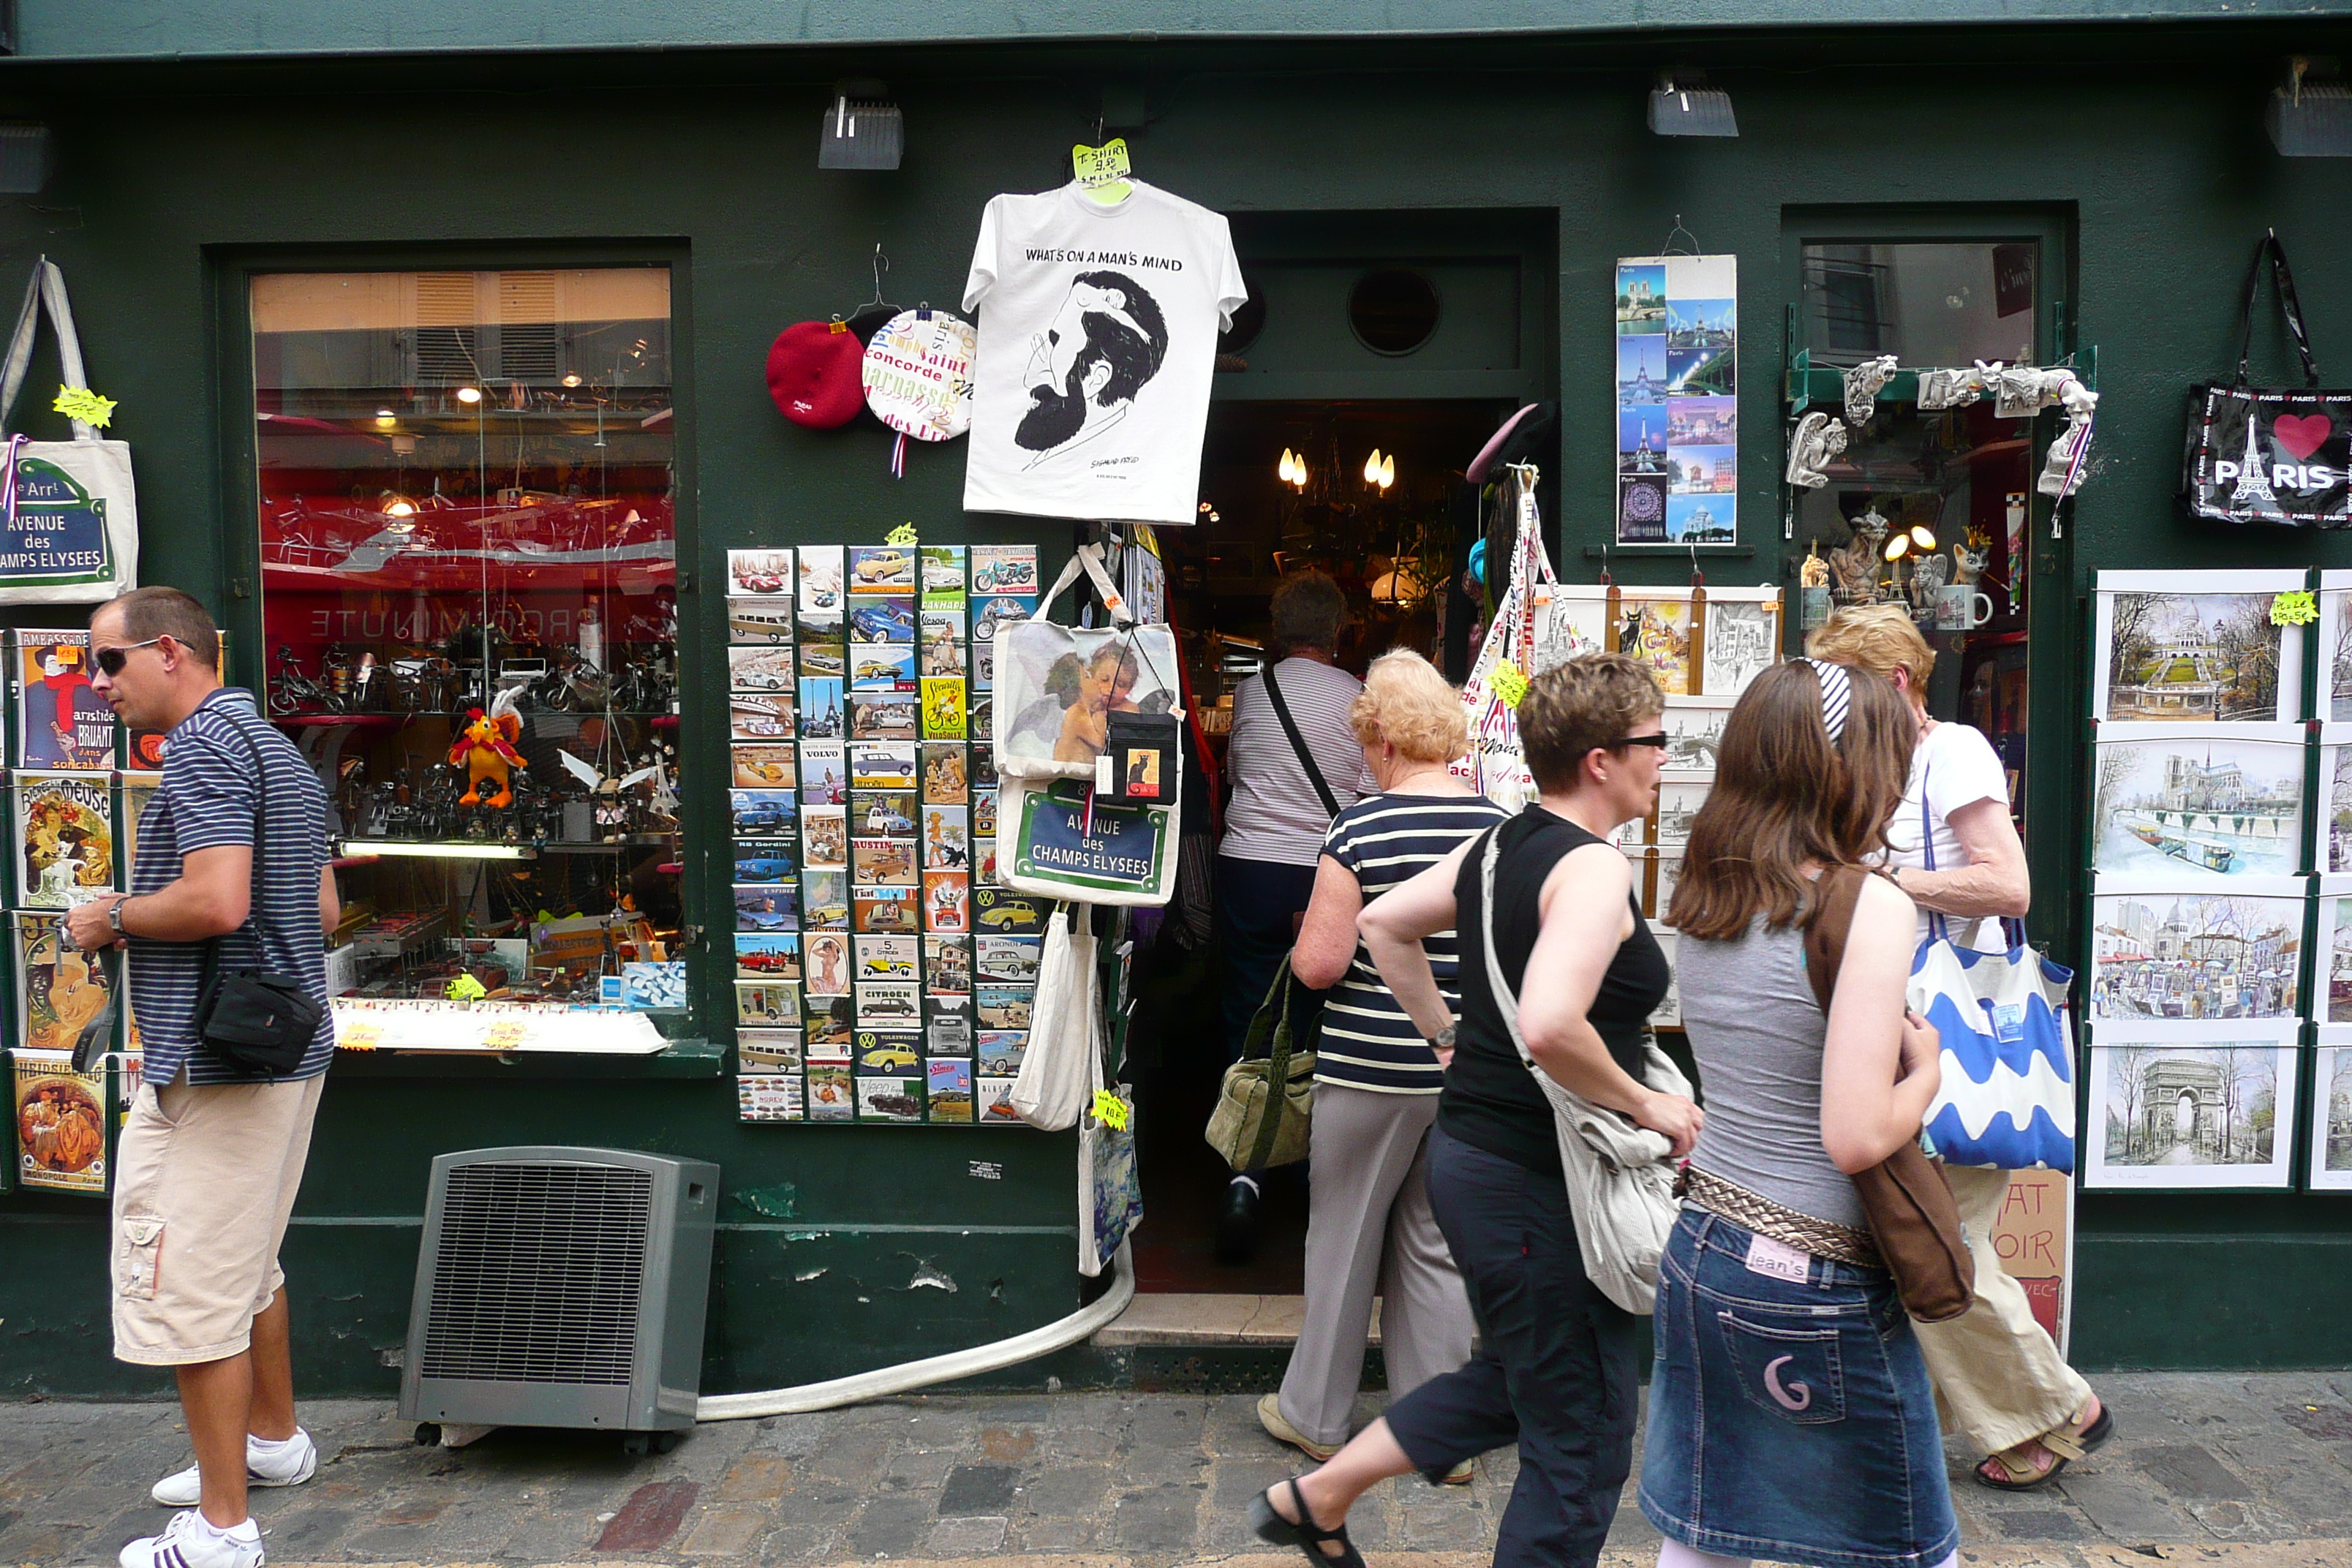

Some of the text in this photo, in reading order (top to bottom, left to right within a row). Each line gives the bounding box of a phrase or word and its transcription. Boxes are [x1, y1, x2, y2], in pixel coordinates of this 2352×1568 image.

[1092, 146, 1126, 161] SHIRT
[1026, 248, 1183, 271] WHAT'S ON A MAN'S MIND
[865, 349, 942, 382] concorde
[2210, 388, 2226, 396] PARIS
[7, 516, 66, 532] AVENUE
[25, 533, 50, 549] des
[0, 550, 101, 568] AMPS ELYSEES
[921, 614, 946, 625] Vespa
[73, 710, 116, 722] aristide
[78, 725, 114, 747] BRUANT
[78, 748, 101, 756] dans
[53, 761, 75, 769] son
[61, 779, 110, 820] MEUSE
[1067, 814, 1120, 835] AVNUE
[853, 841, 892, 849] AUSTIN
[1082, 837, 1104, 851] des
[1033, 844, 1148, 875] CHAMPS ELYSEES
[884, 941, 892, 949] 5
[26, 1170, 68, 1182] MONOPOLE
[2005, 1183, 2049, 1215] AT
[1994, 1230, 2057, 1267] OIR
[1749, 1251, 1803, 1276] jean's
